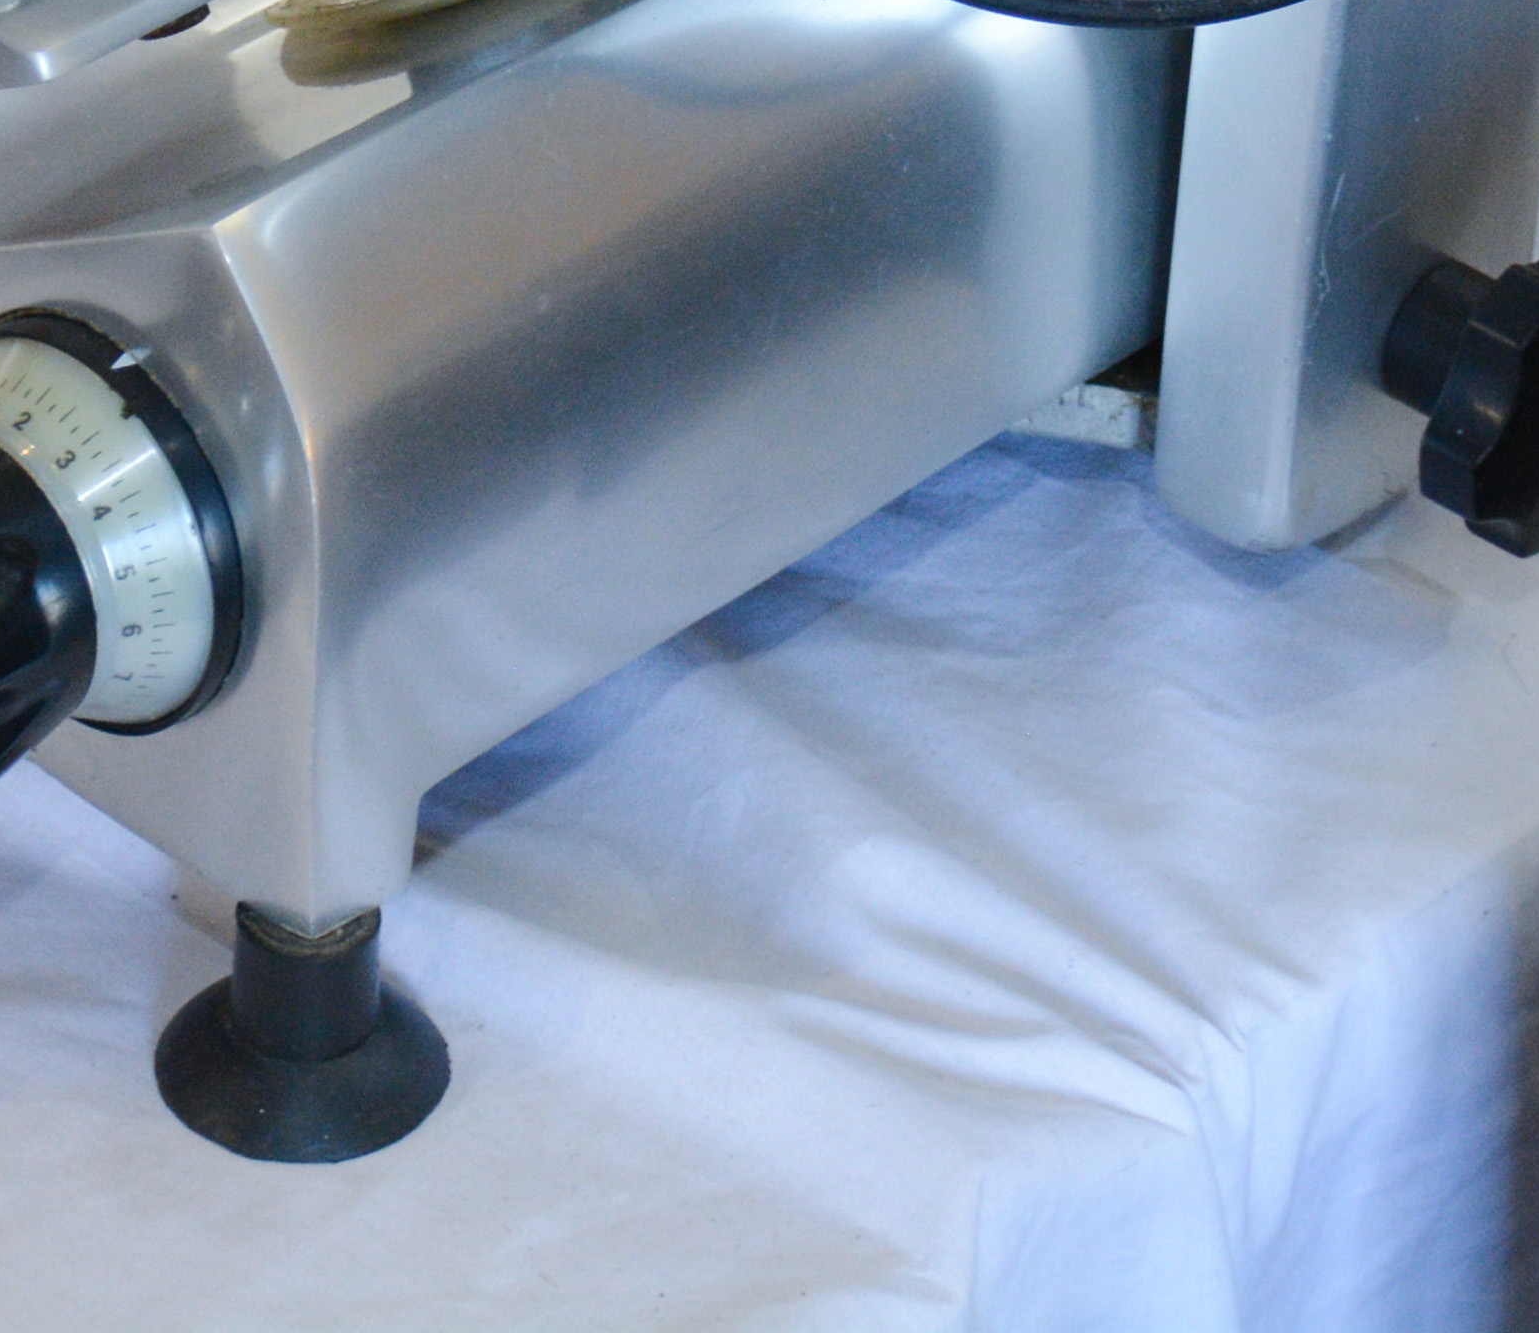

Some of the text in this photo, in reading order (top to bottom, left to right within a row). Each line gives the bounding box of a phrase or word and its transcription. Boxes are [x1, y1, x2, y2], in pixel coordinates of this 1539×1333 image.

[13, 411, 33, 432] 2
[55, 449, 76, 470] 3
[93, 504, 113, 522] 4
[115, 564, 137, 582] 5
[121, 623, 142, 638] 6
[113, 672, 132, 683] 7
